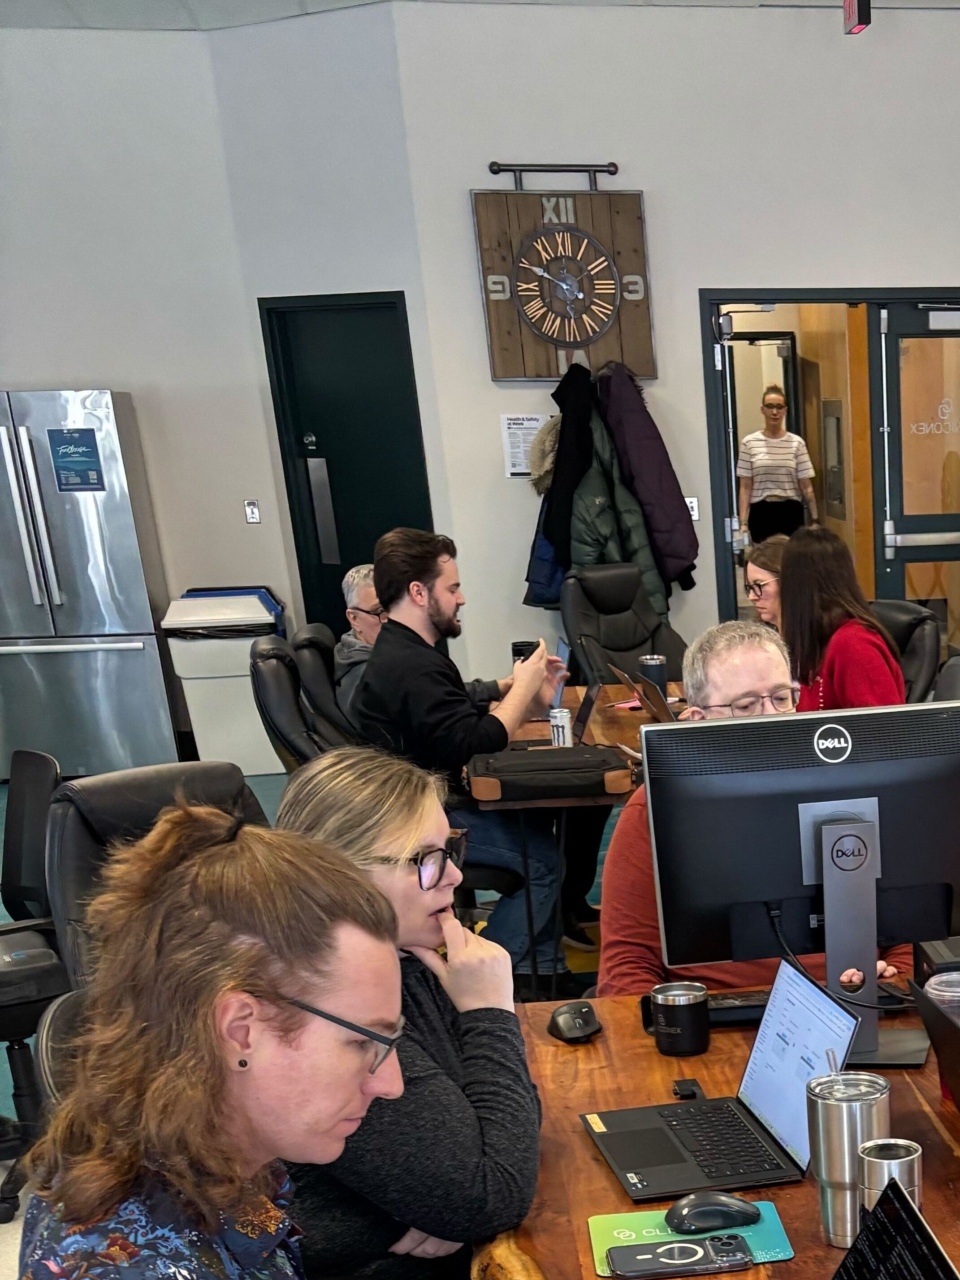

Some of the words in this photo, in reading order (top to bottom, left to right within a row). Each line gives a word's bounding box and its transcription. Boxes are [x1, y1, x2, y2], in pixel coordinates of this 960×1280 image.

[541, 197, 575, 224] XII
[555, 232, 573, 257] XII
[487, 275, 511, 301] 9
[593, 280, 616, 294] III
[622, 275, 645, 301] 3
[818, 738, 848, 750] DELL
[836, 848, 864, 859] DELL
